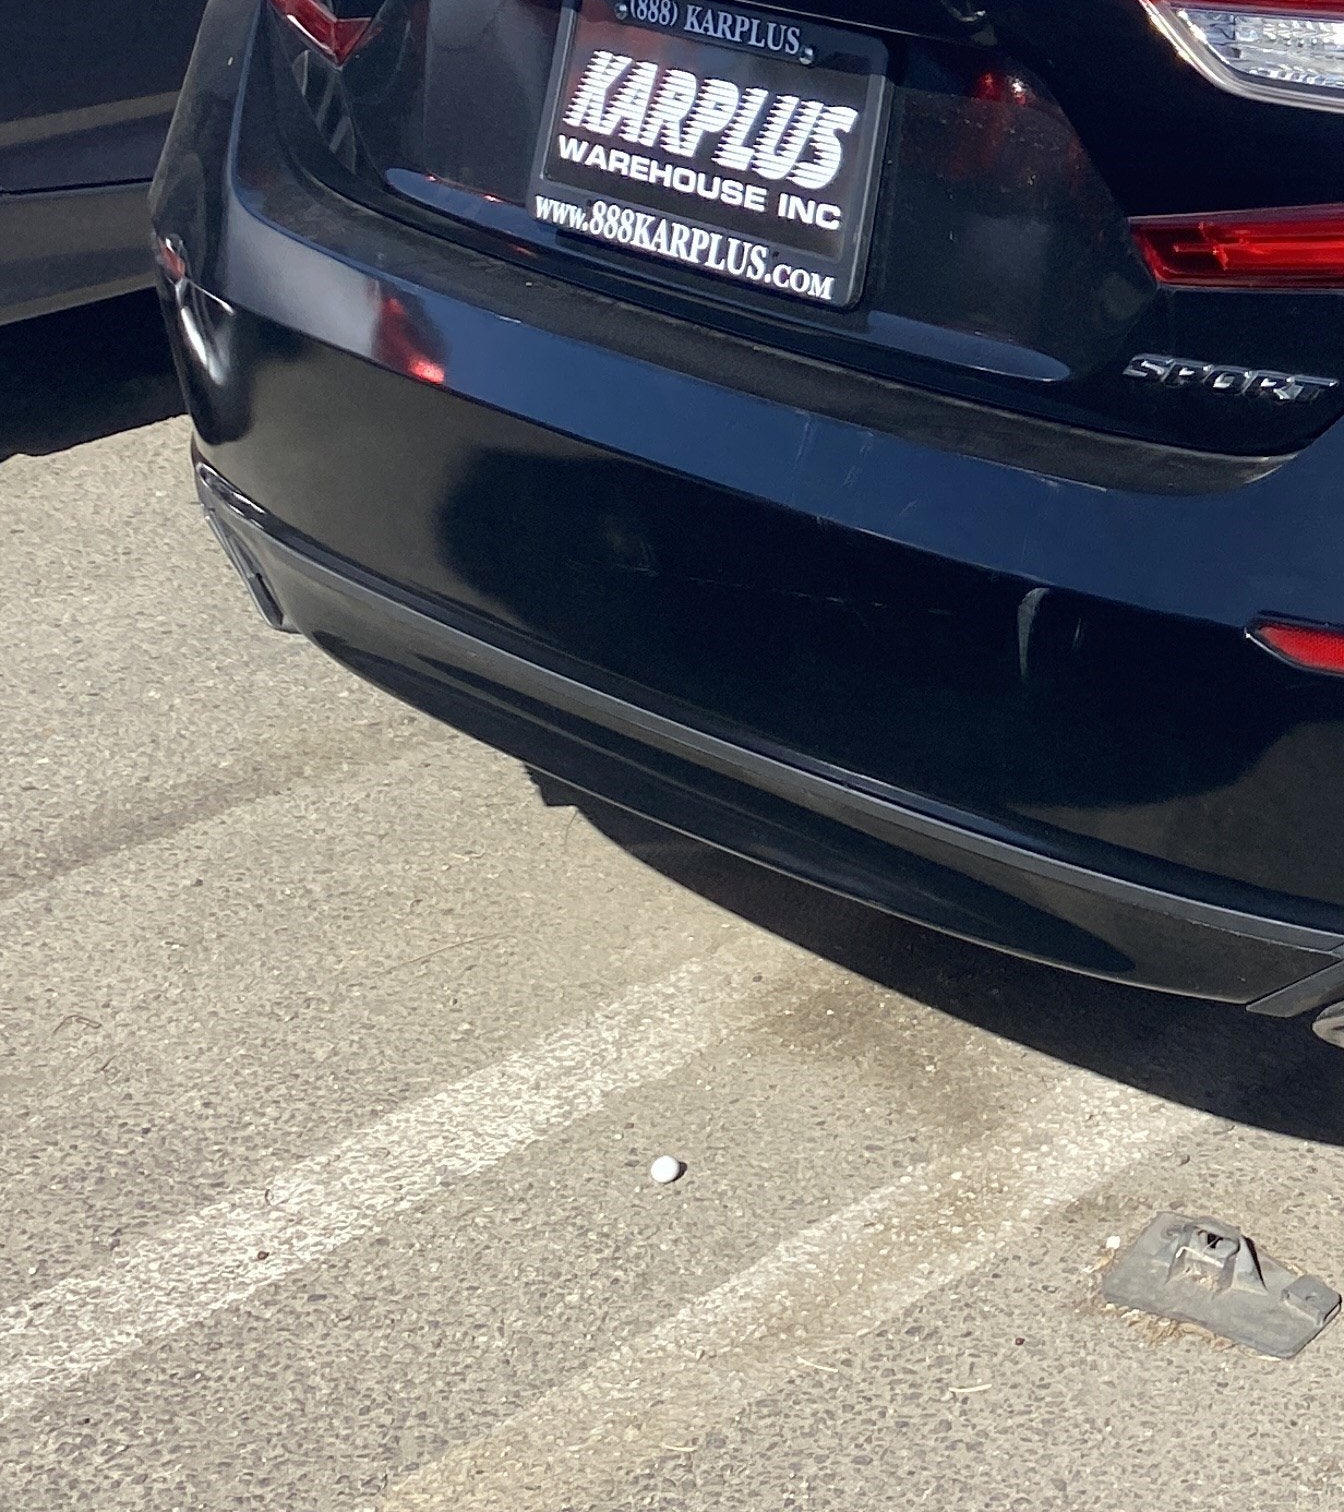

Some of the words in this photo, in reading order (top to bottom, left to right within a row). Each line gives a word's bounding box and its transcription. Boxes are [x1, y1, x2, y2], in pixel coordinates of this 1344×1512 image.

[684, 5, 802, 53] KARPLUS
[562, 49, 859, 189] KARPLUS
[559, 134, 767, 213] WAREHOUSE
[778, 191, 842, 230] INC
[1122, 352, 1340, 403] SPORT
